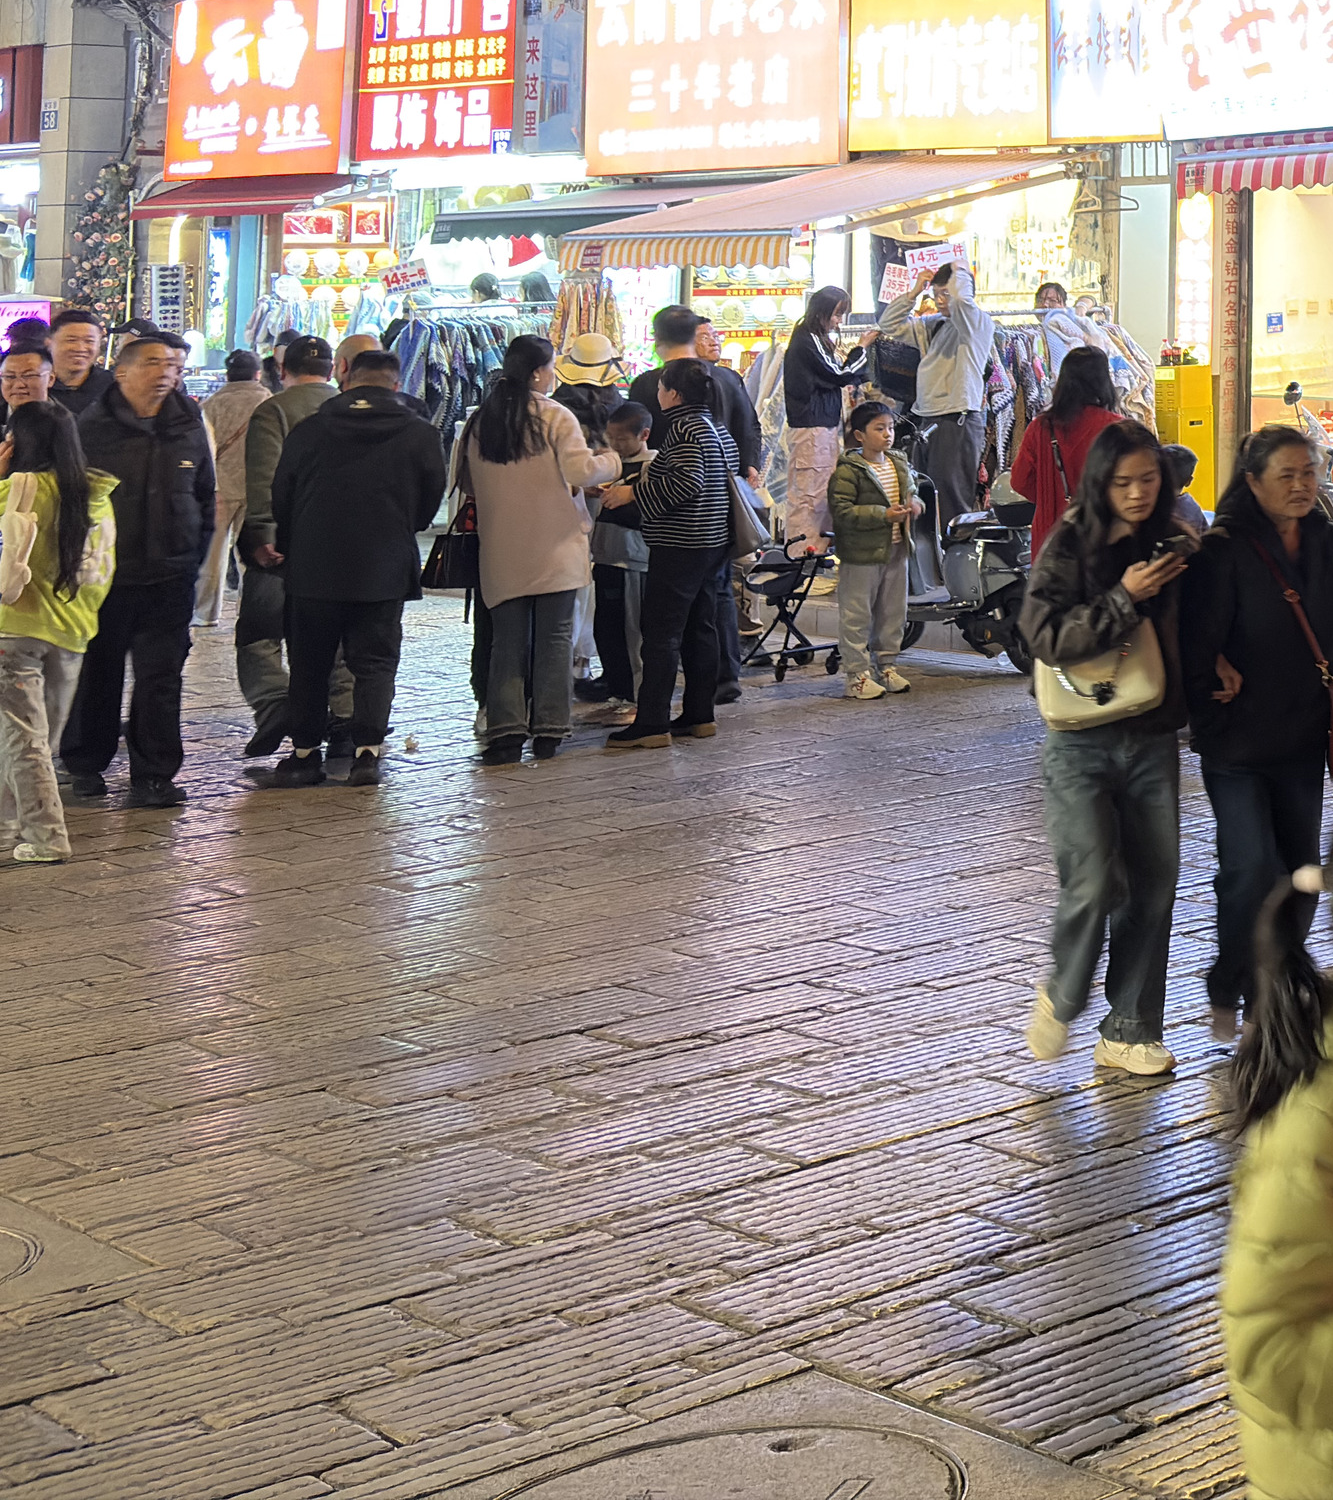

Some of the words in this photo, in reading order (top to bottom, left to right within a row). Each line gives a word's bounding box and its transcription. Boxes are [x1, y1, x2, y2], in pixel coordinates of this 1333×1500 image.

[524, 37, 540, 137] 来这里
[44, 112, 56, 129] 58
[909, 243, 964, 265] 14元一件
[382, 268, 426, 288] 14元一件
